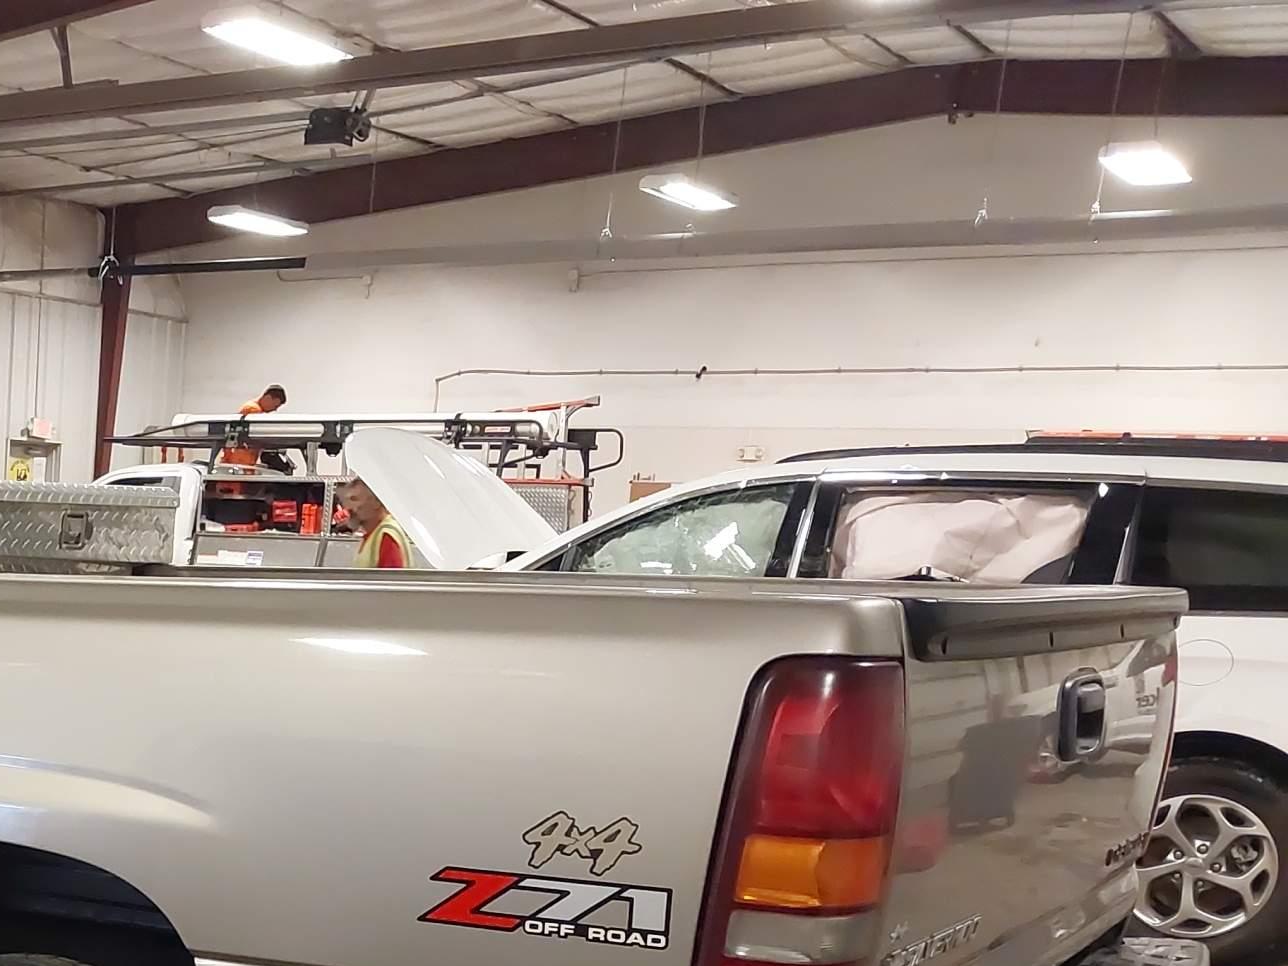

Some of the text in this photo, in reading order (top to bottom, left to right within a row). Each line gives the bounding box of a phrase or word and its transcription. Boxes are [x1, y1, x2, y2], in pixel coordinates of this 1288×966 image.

[523, 811, 642, 876] 4x4
[418, 867, 672, 932] Z71
[523, 919, 667, 949] OFF ROAD
